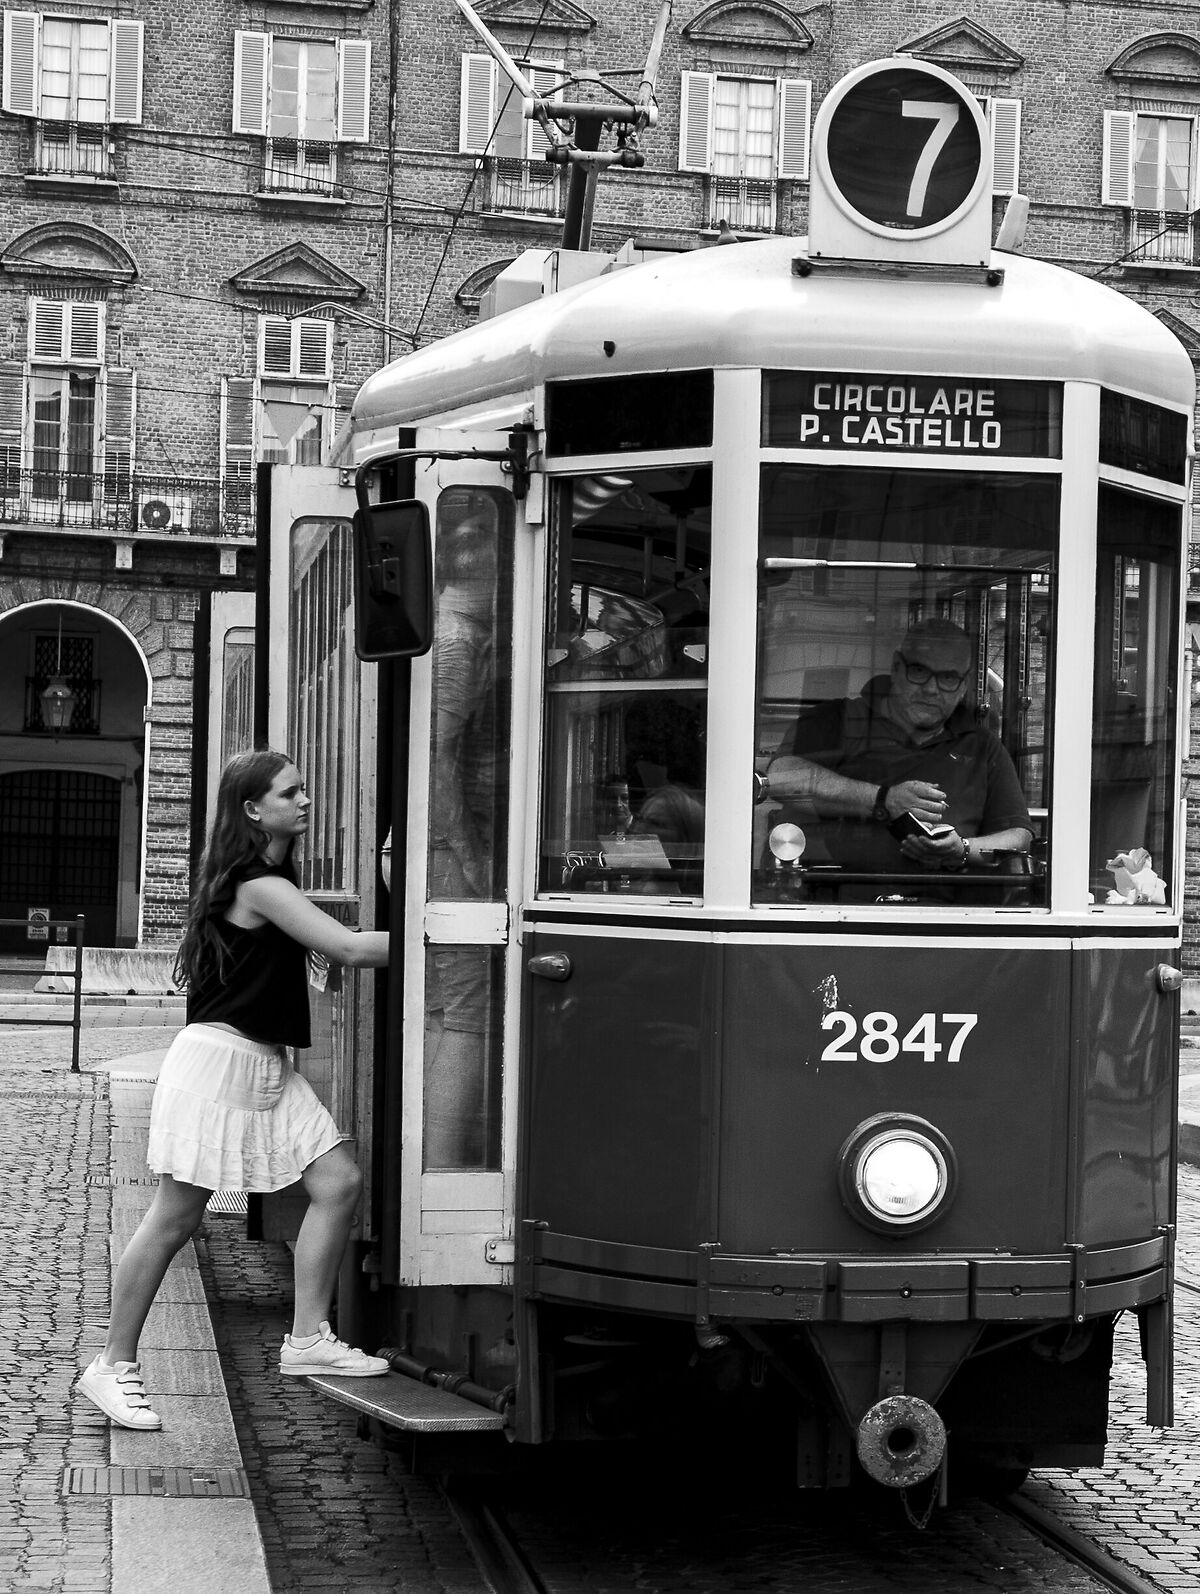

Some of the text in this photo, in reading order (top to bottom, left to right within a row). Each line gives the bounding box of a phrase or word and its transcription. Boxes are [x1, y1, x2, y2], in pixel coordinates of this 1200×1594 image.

[902, 100, 959, 217] 7
[813, 382, 996, 417] CIRCOLARE
[800, 413, 1002, 449] P. CASTELLO
[820, 1011, 978, 1063] 2847
